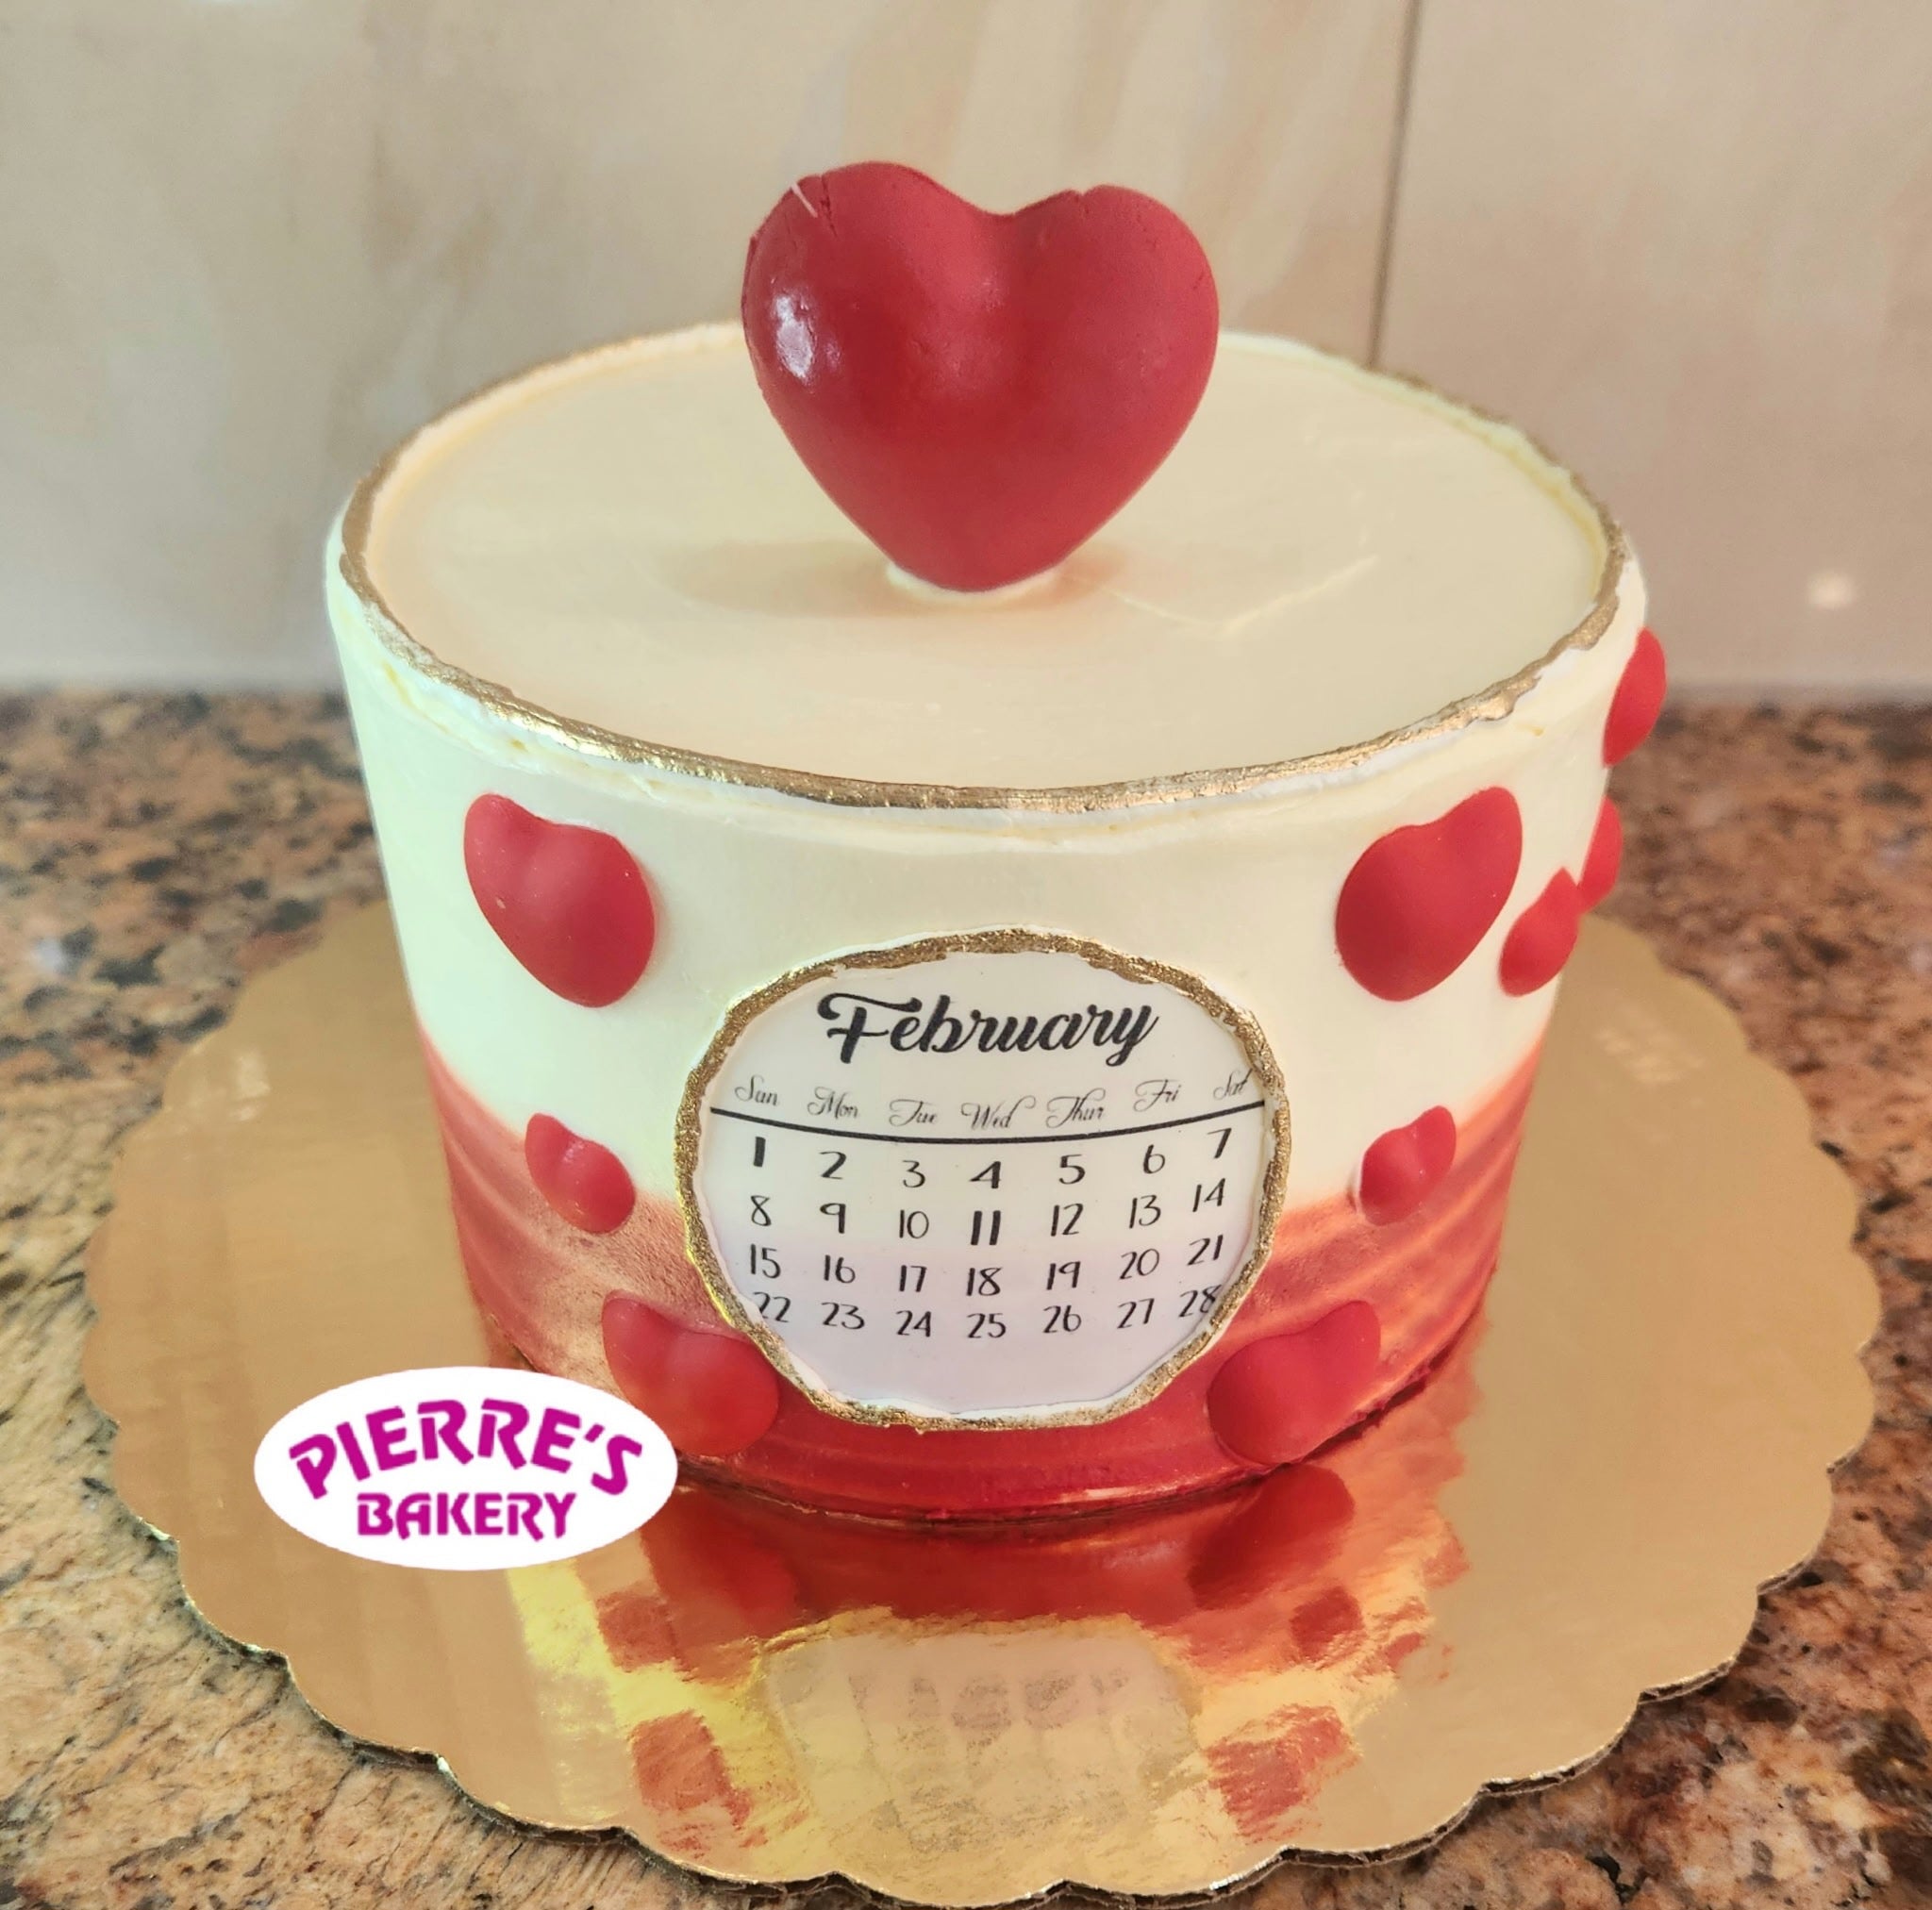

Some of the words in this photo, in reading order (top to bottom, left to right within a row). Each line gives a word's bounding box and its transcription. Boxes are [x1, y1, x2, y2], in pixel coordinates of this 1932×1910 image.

[816, 991, 1160, 1068] February
[734, 1075, 778, 1106] Sun
[807, 1086, 858, 1121] Mon
[888, 1098, 938, 1126] Tue
[960, 1095, 1037, 1130] Wed
[1045, 1088, 1107, 1128] Thur
[1133, 1078, 1182, 1112] Fri
[1212, 1068, 1254, 1101] Sat
[752, 1136, 767, 1169] 1
[819, 1151, 847, 1181] 2
[902, 1159, 926, 1188] 3
[968, 1160, 1002, 1190] 4
[1058, 1154, 1087, 1186] 5
[1141, 1143, 1166, 1175] 6
[1207, 1126, 1233, 1160] 7
[750, 1194, 773, 1227] 8
[819, 1202, 847, 1235] 9
[898, 1208, 930, 1239] 10
[969, 1209, 1002, 1247] 11
[1050, 1203, 1084, 1237] 12
[1128, 1193, 1162, 1230] 13
[1191, 1177, 1226, 1213] 14
[749, 1242, 782, 1280] 15
[823, 1254, 857, 1285] 16
[898, 1264, 928, 1293] 17
[965, 1267, 1003, 1297] 18
[1045, 1260, 1082, 1291] 19
[1118, 1248, 1160, 1281] 20
[1185, 1234, 1224, 1267] 21
[752, 1290, 791, 1323] 22
[821, 1302, 866, 1331] 23
[895, 1309, 932, 1338] 24
[966, 1312, 1008, 1339] 25
[1042, 1304, 1083, 1335] 26
[1116, 1297, 1156, 1330] 27
[1177, 1283, 1224, 1318] 28
